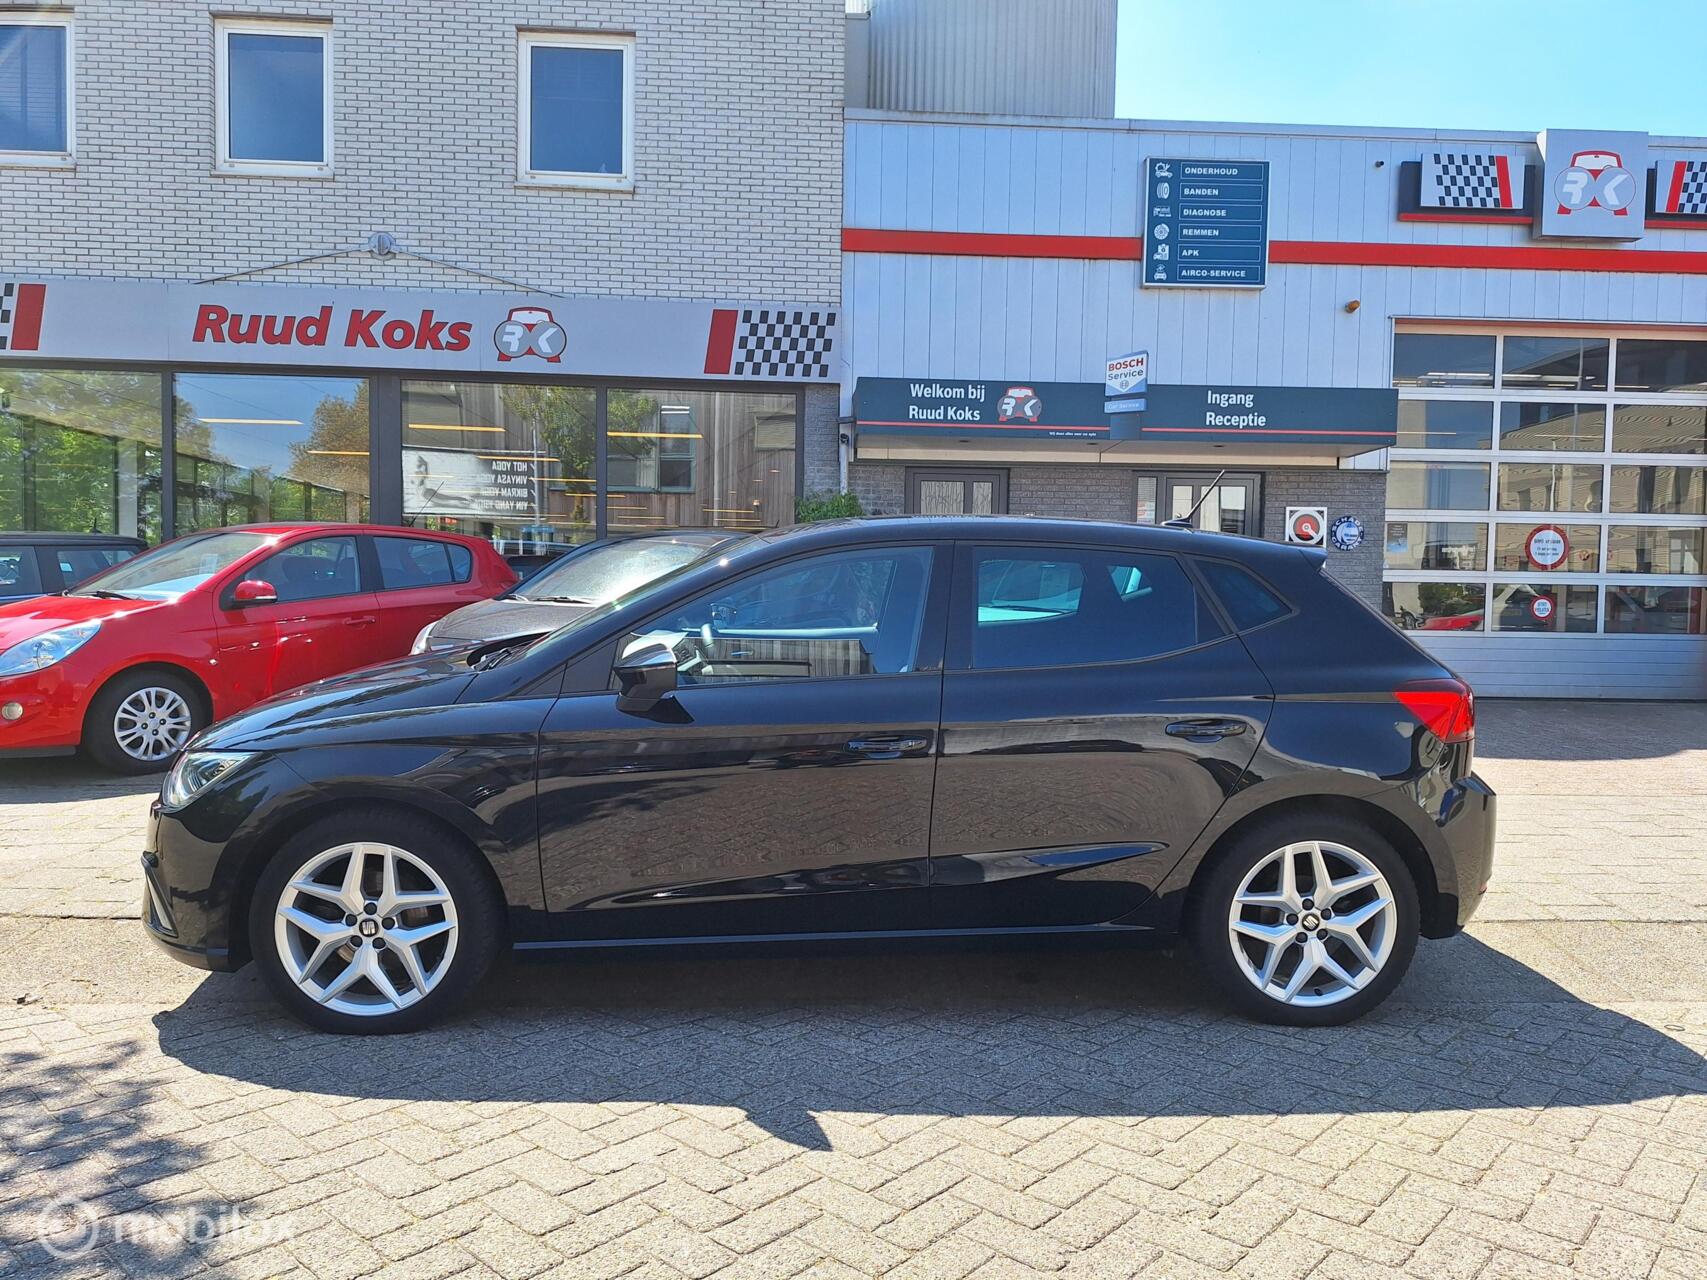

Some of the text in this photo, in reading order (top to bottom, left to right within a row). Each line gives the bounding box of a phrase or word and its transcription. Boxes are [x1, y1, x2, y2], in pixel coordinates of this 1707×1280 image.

[1184, 167, 1239, 176] ONDERHOUD
[1183, 187, 1219, 196] BANDEN
[1183, 208, 1227, 217] DIAGNOSE
[1182, 228, 1219, 237] REMMEN
[1181, 249, 1200, 257] APK
[1181, 269, 1246, 278] AIRCO-SERVICE
[192, 304, 473, 352] Ruud Koks
[1108, 357, 1144, 372] BOSCH
[1107, 369, 1144, 381] Service
[910, 383, 986, 403] Welkom bij
[1207, 390, 1254, 408] Ingang
[908, 405, 981, 421] Ruud Koks
[1205, 411, 1267, 429] Receptie
[1331, 516, 1364, 532] SCHADE
